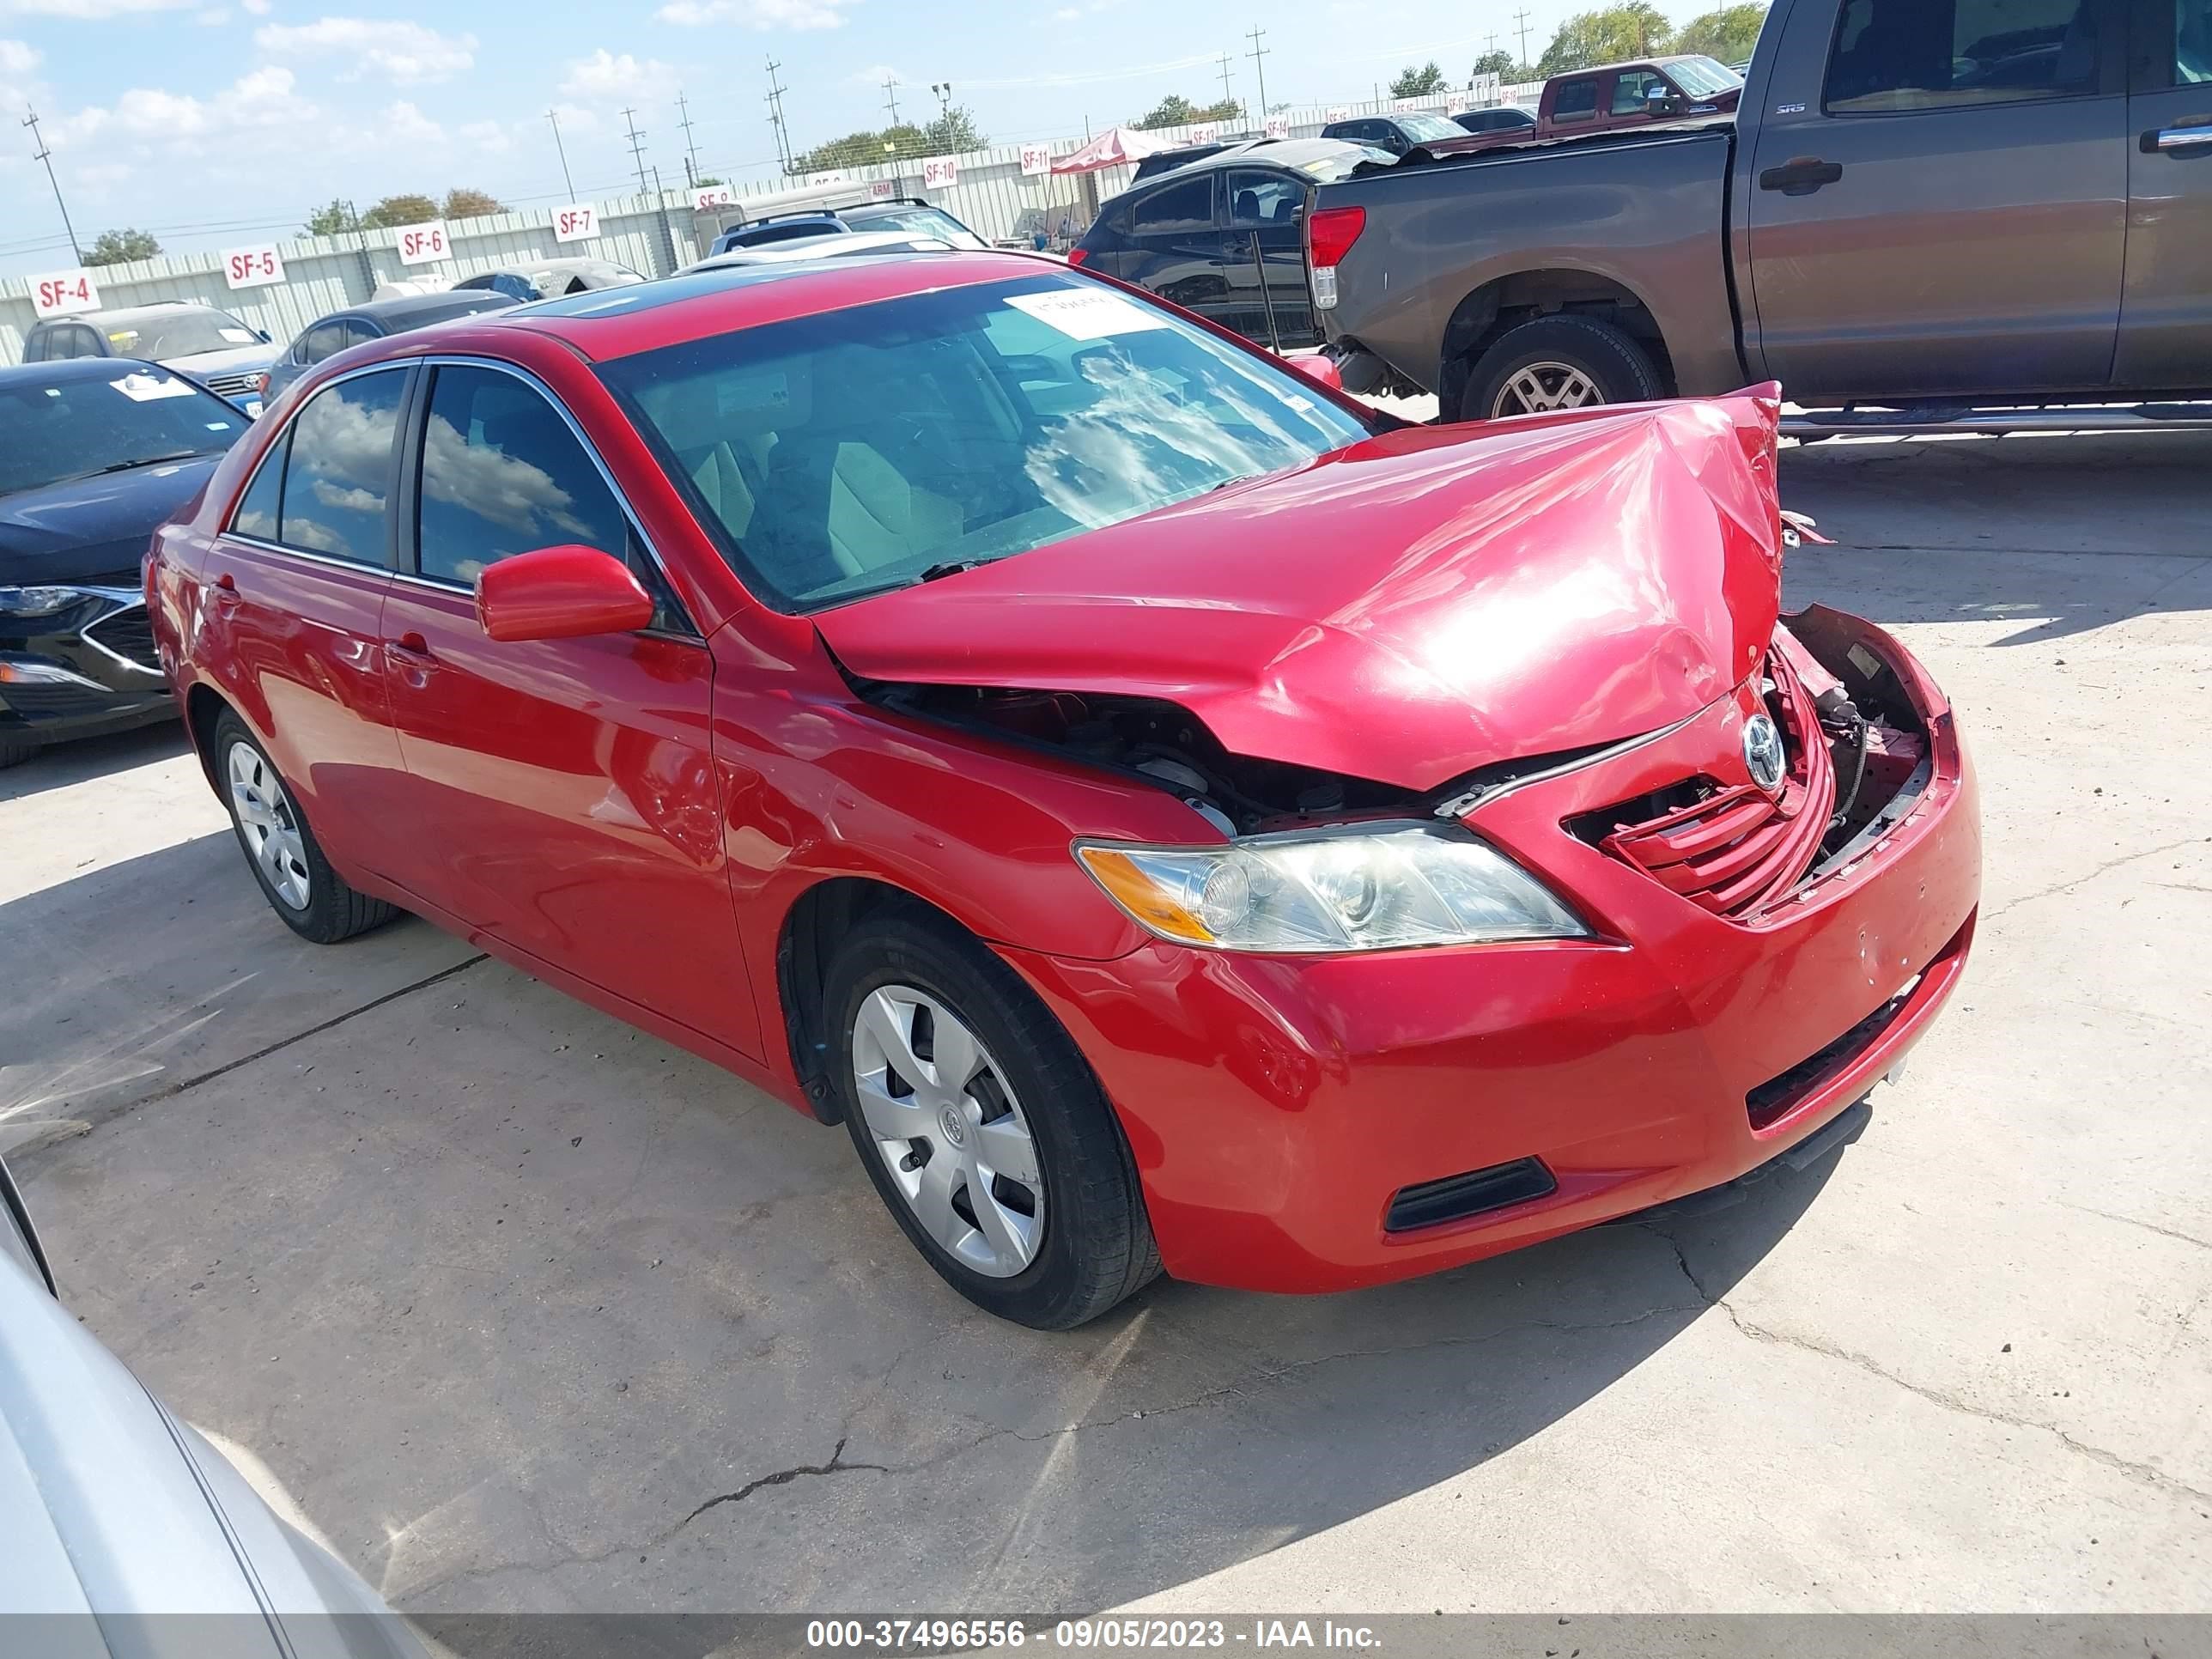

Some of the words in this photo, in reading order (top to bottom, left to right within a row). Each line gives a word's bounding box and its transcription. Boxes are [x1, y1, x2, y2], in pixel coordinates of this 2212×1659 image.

[1449, 97, 1464, 112] SF-17
[1501, 90, 1516, 104] SF-18
[1194, 129, 1215, 145] SF-13
[1267, 120, 1286, 137] SF-14
[1023, 149, 1048, 169] SF-11
[926, 161, 954, 182] SF-10
[560, 210, 591, 234] SF-7
[404, 230, 442, 256] SF-6
[231, 252, 274, 280] SF-5
[40, 277, 89, 307] SF-4
